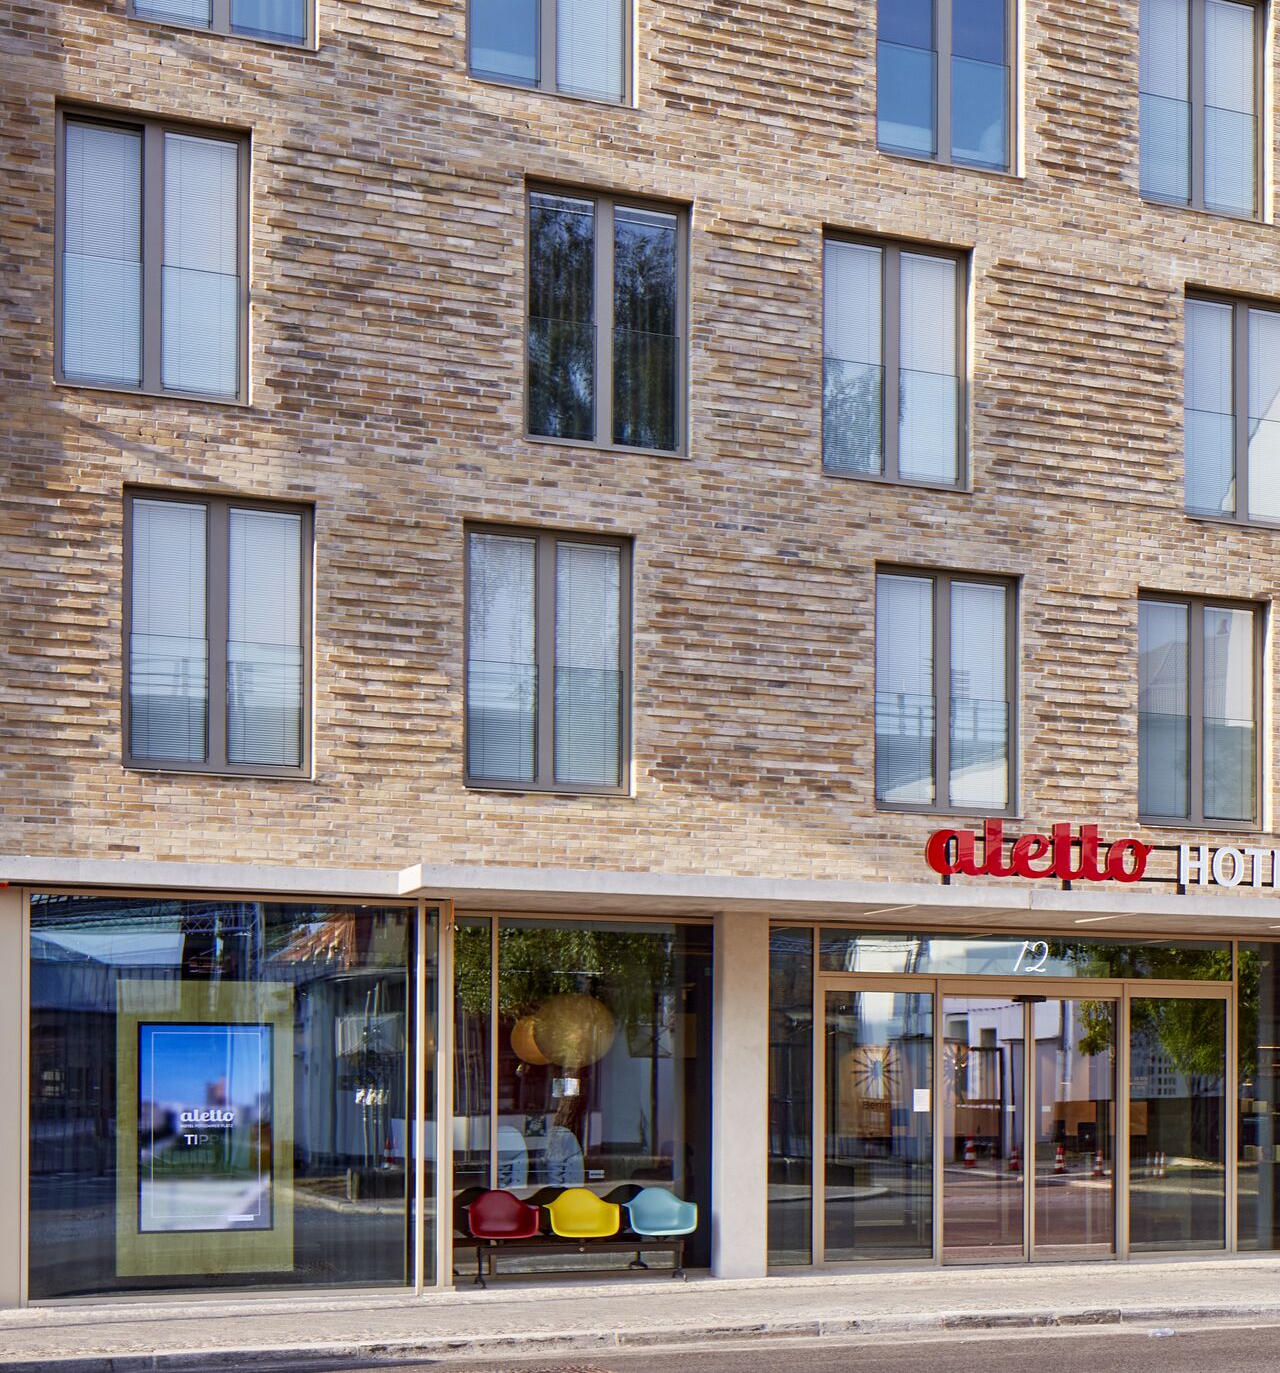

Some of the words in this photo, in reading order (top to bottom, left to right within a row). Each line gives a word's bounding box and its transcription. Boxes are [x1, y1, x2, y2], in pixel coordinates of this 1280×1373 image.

[926, 818, 1155, 883] aletto
[1012, 940, 1049, 973] 12
[180, 1109, 235, 1122] aletto
